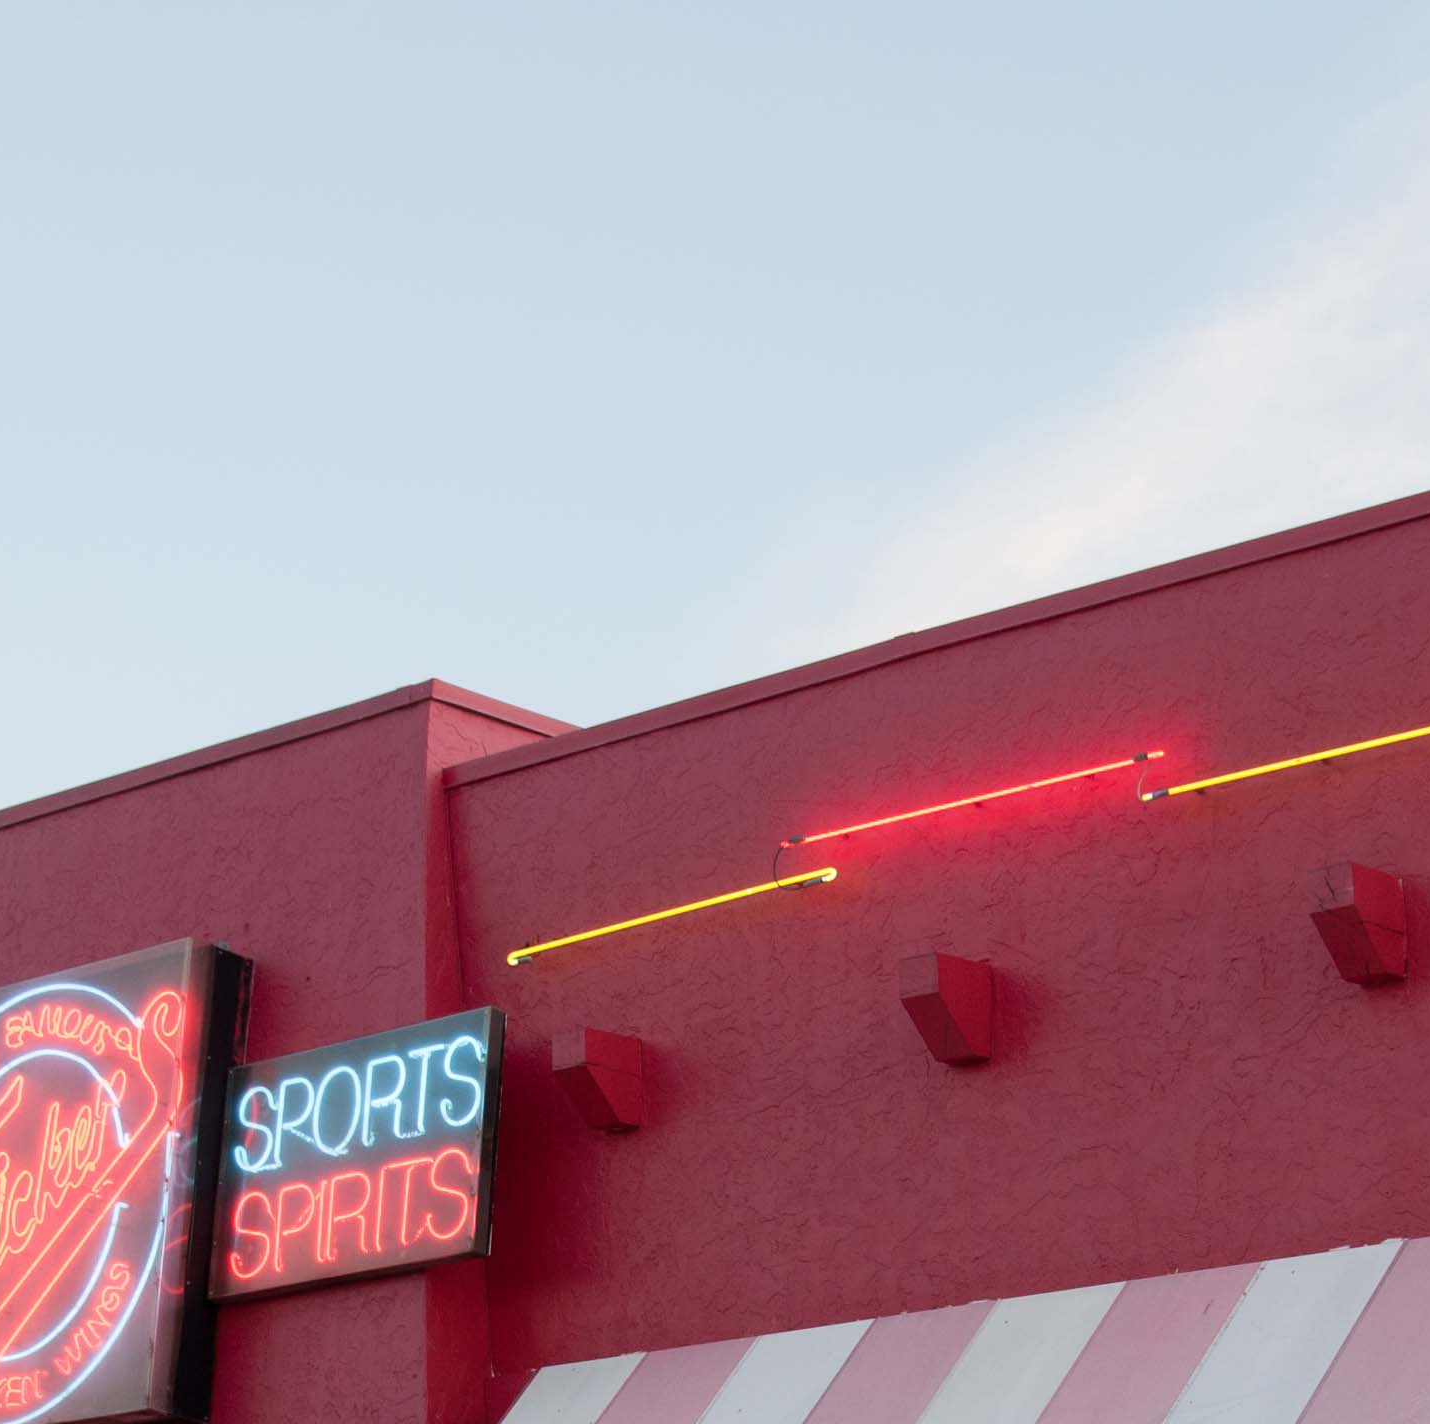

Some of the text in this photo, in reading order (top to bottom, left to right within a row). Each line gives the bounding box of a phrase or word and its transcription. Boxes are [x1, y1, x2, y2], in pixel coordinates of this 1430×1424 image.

[234, 1035, 488, 1173] SPORTS
[229, 1149, 475, 1279] SPIRITS
[55, 1262, 130, 1376] WINGS
